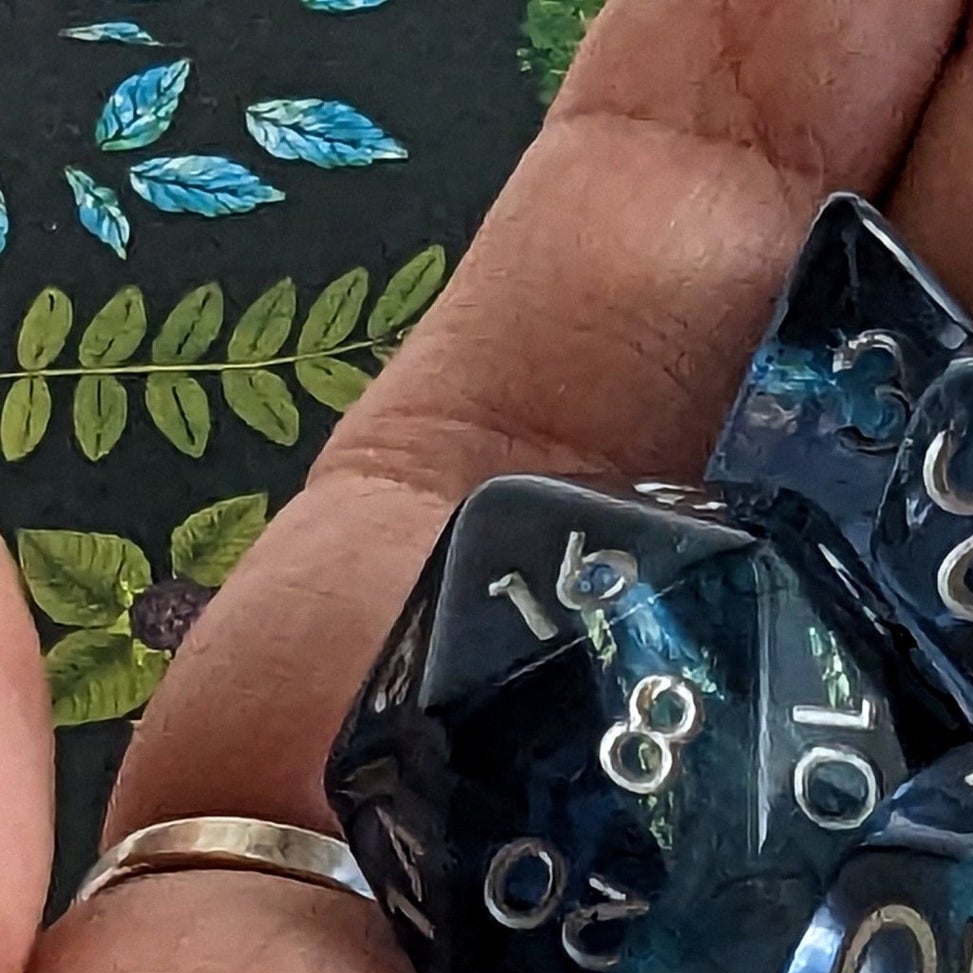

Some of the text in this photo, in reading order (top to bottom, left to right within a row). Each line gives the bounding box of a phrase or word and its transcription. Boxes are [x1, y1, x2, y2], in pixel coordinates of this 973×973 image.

[489, 531, 640, 641] 16
[600, 674, 698, 794] 8
[792, 700, 880, 831] 10
